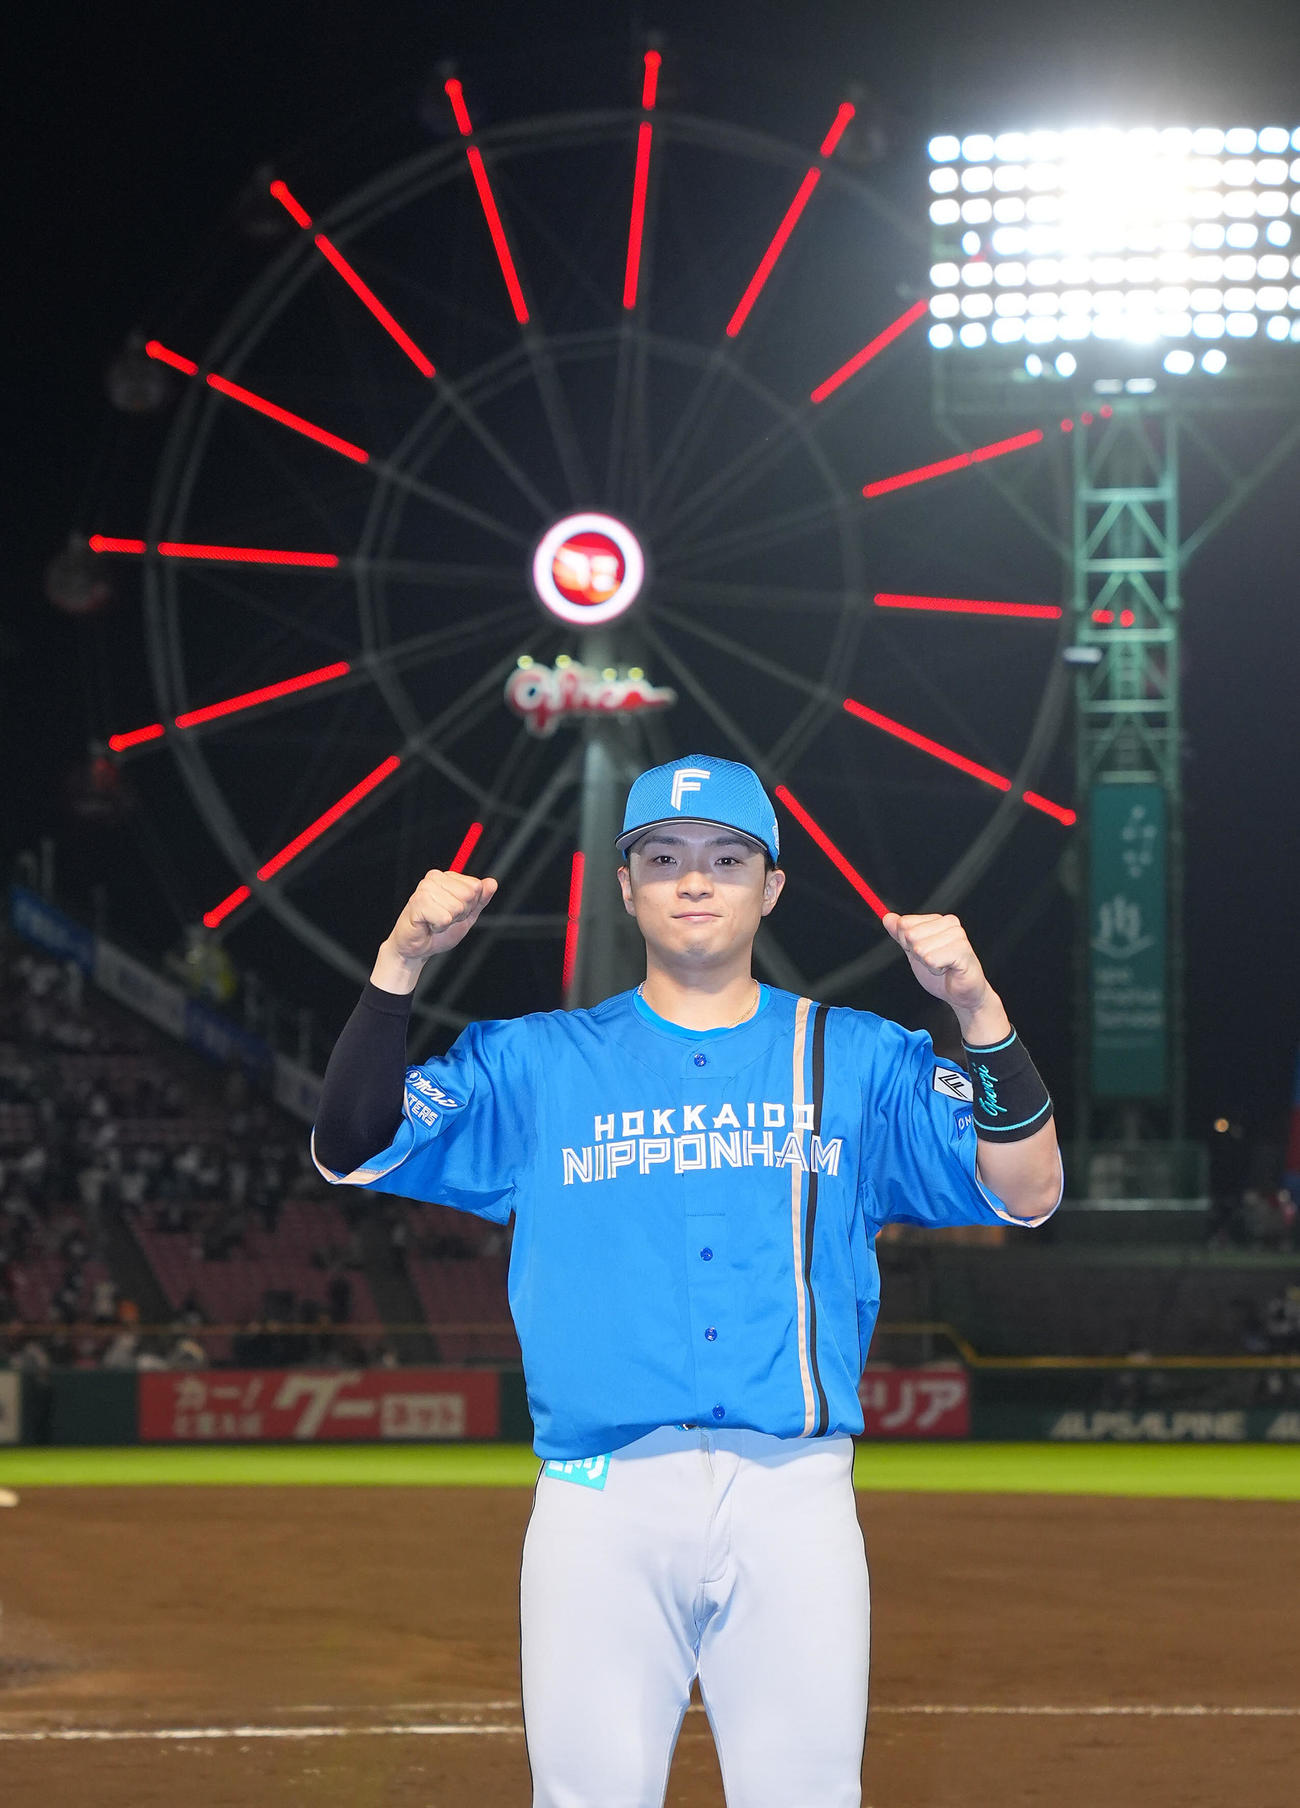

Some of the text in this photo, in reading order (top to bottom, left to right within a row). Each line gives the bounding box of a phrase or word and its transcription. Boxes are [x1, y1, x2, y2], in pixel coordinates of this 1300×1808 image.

[671, 768, 711, 811] F
[408, 1092, 439, 1127] TERS
[594, 1102, 815, 1141] HOKKAIDO
[561, 1130, 843, 1186] NIPPONHAM
[861, 1377, 964, 1430] リア
